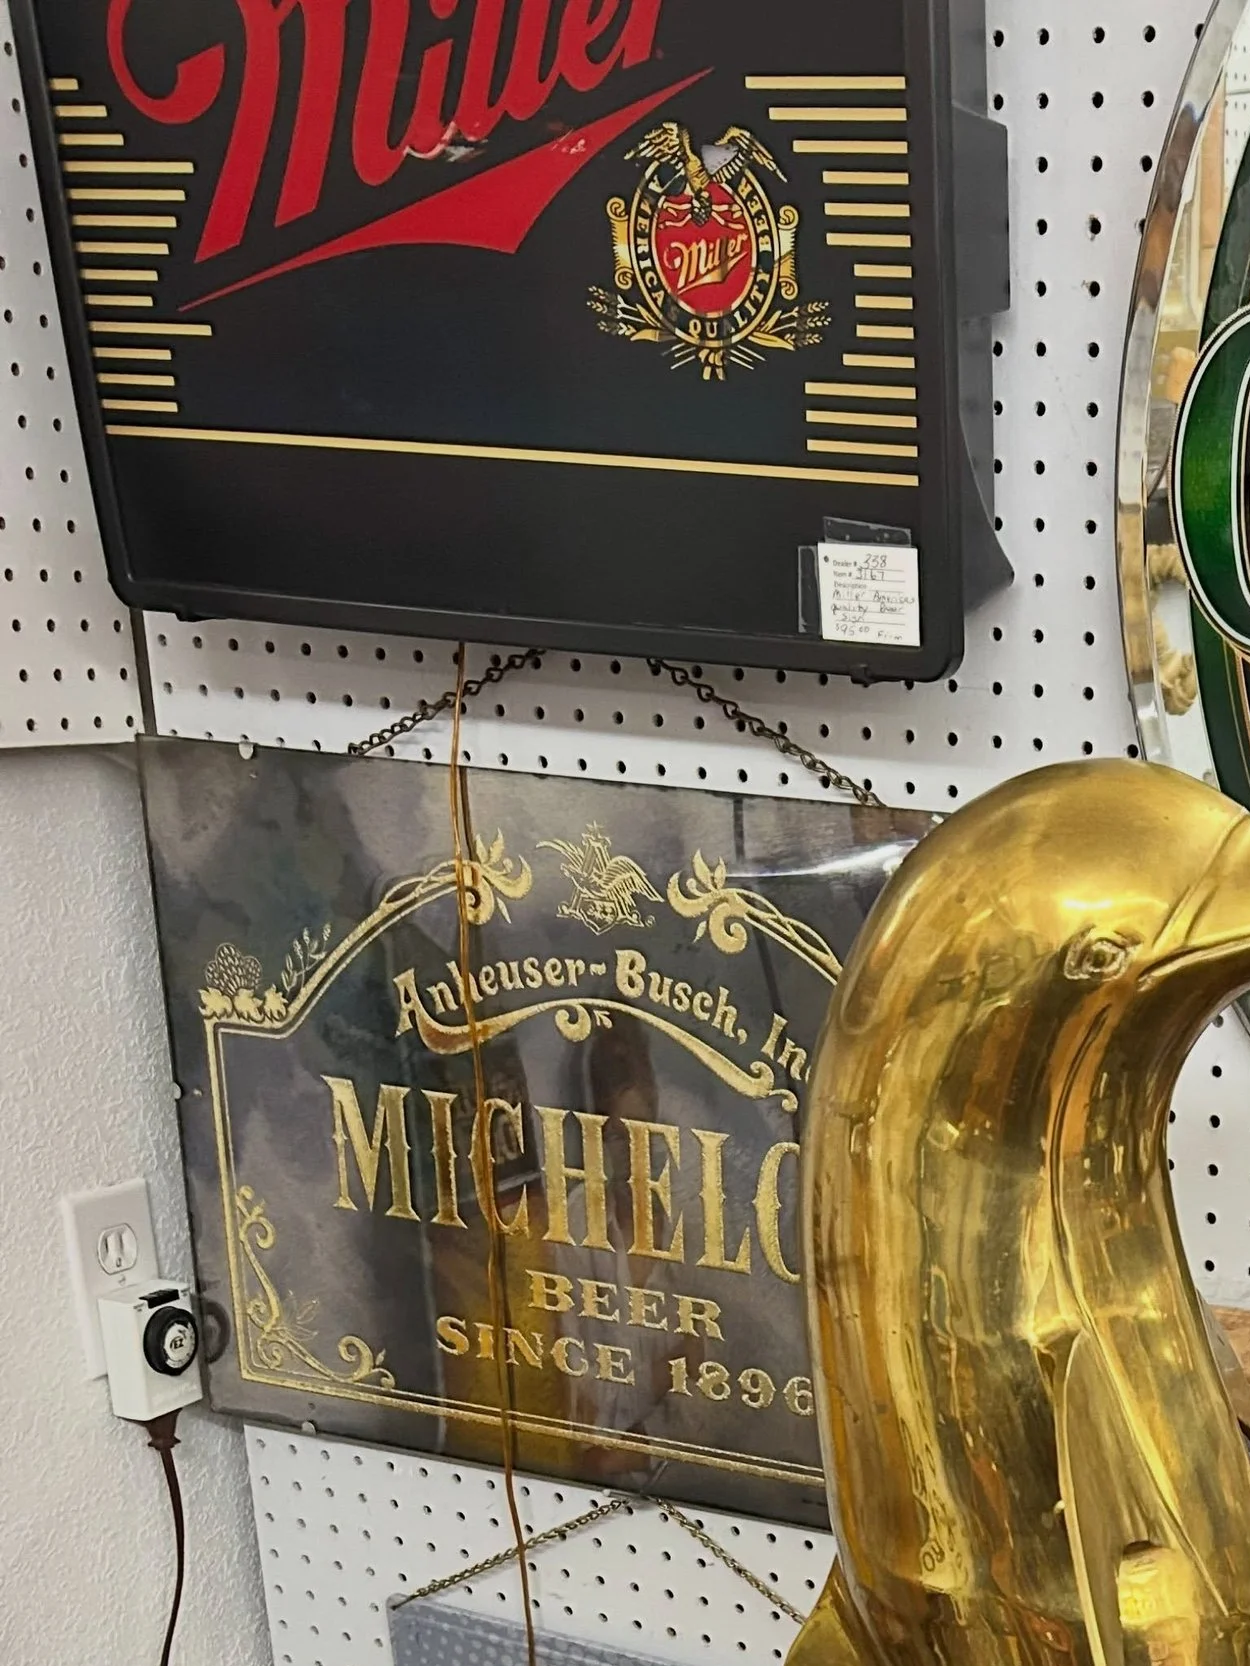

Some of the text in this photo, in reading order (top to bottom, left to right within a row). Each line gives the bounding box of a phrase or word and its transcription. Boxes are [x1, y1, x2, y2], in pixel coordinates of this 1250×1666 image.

[106, 0, 656, 263] Miller
[663, 232, 749, 289] Miller
[736, 178, 773, 252] BEER
[391, 949, 812, 1082] Anheuser-Busch, In
[320, 1074, 804, 1285] MICHELO
[525, 1268, 725, 1342] BEER
[435, 1314, 815, 1417] SINCE 1896
